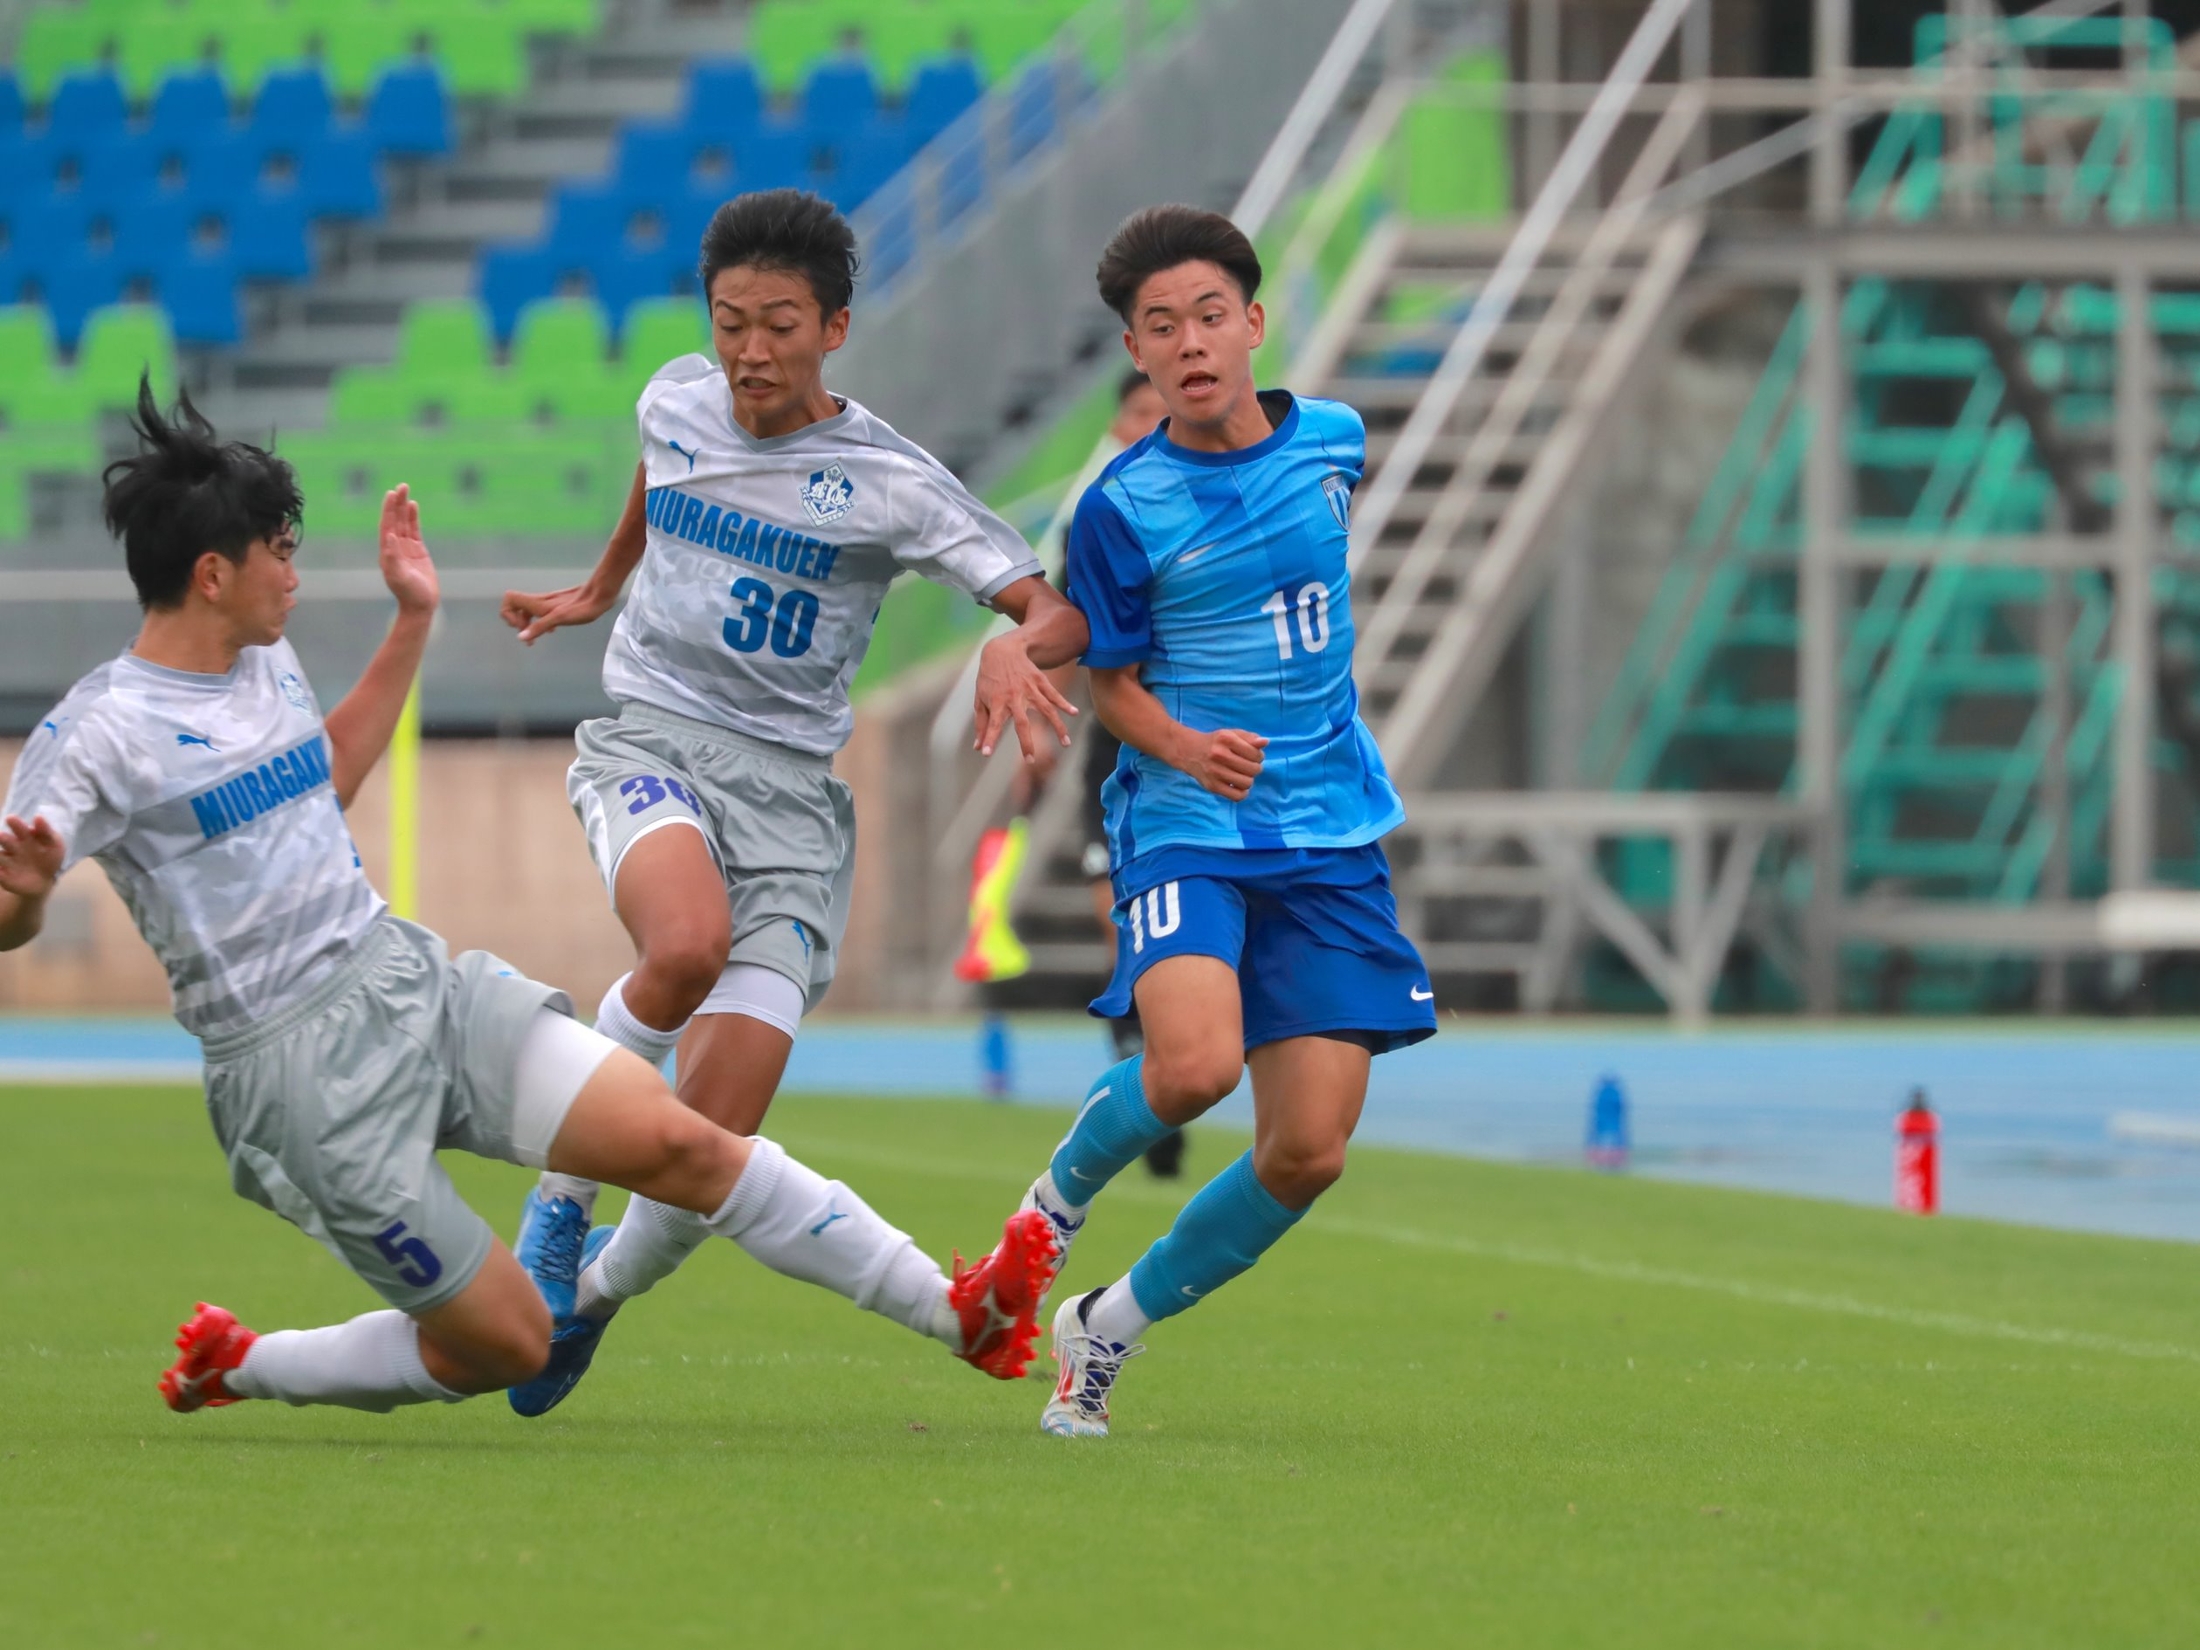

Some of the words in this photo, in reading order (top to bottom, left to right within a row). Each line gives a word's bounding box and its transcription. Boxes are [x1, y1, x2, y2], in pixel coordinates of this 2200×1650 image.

[722, 577, 820, 658] 30
[1261, 581, 1330, 660] 10
[620, 775, 702, 818] 30
[1129, 880, 1181, 954] 10
[373, 1220, 443, 1288] 5
